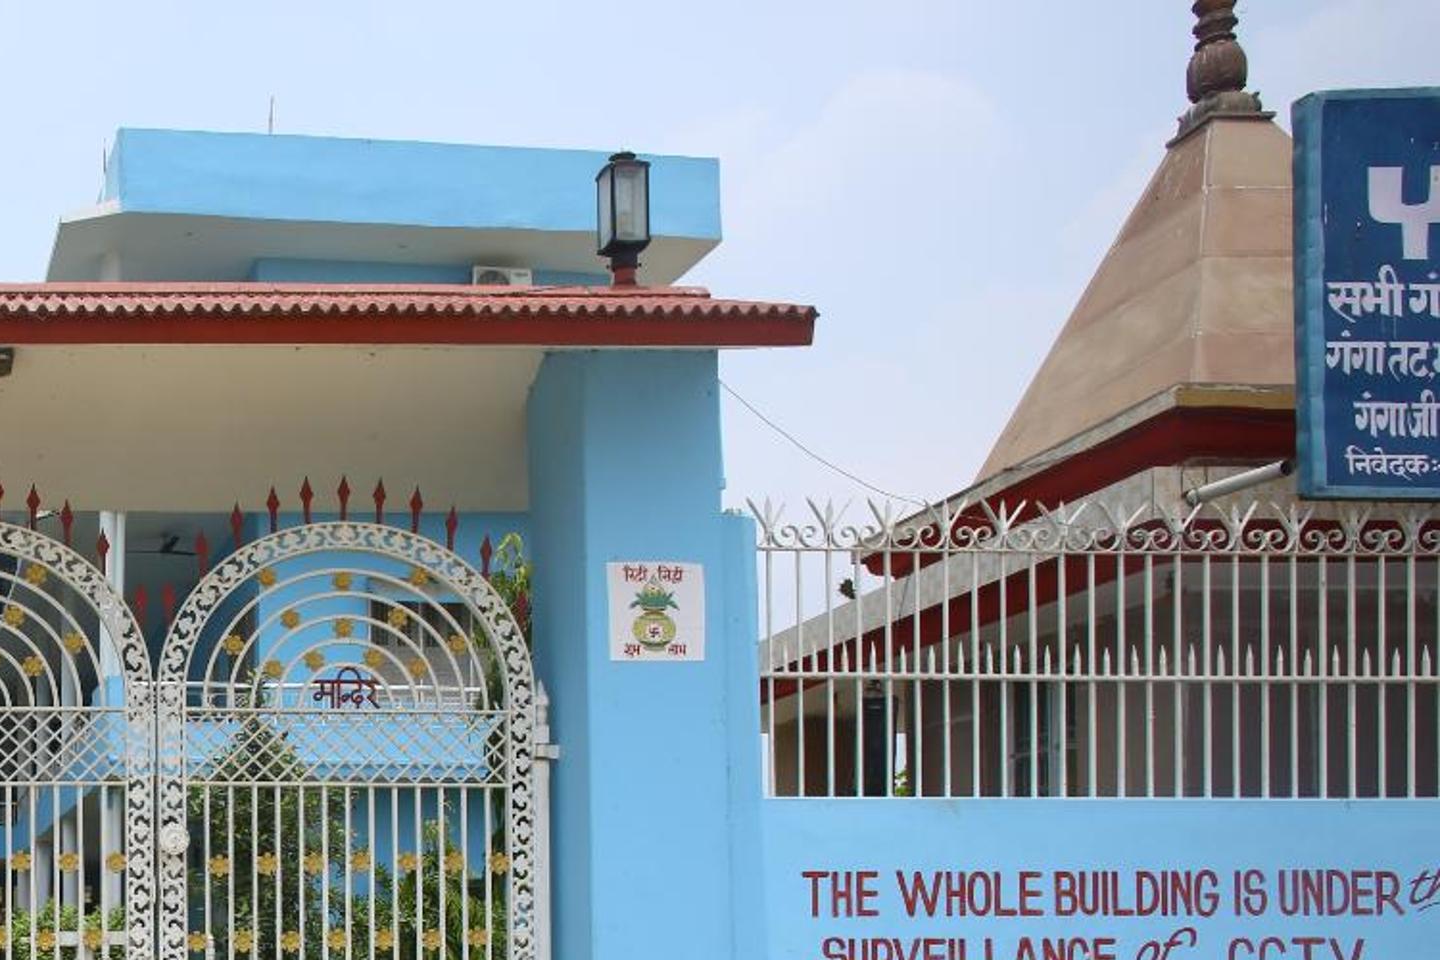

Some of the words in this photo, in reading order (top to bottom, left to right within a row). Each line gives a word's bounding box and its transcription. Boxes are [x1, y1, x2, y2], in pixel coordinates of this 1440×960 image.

[1326, 264, 1404, 323] सभी
[1326, 329, 1387, 376] गंगा
[802, 871, 879, 917] THE
[896, 871, 1044, 918] WHOLE
[1055, 870, 1220, 917] BUILDING
[1234, 870, 1268, 916] IS
[1279, 869, 1405, 917] UNDER
